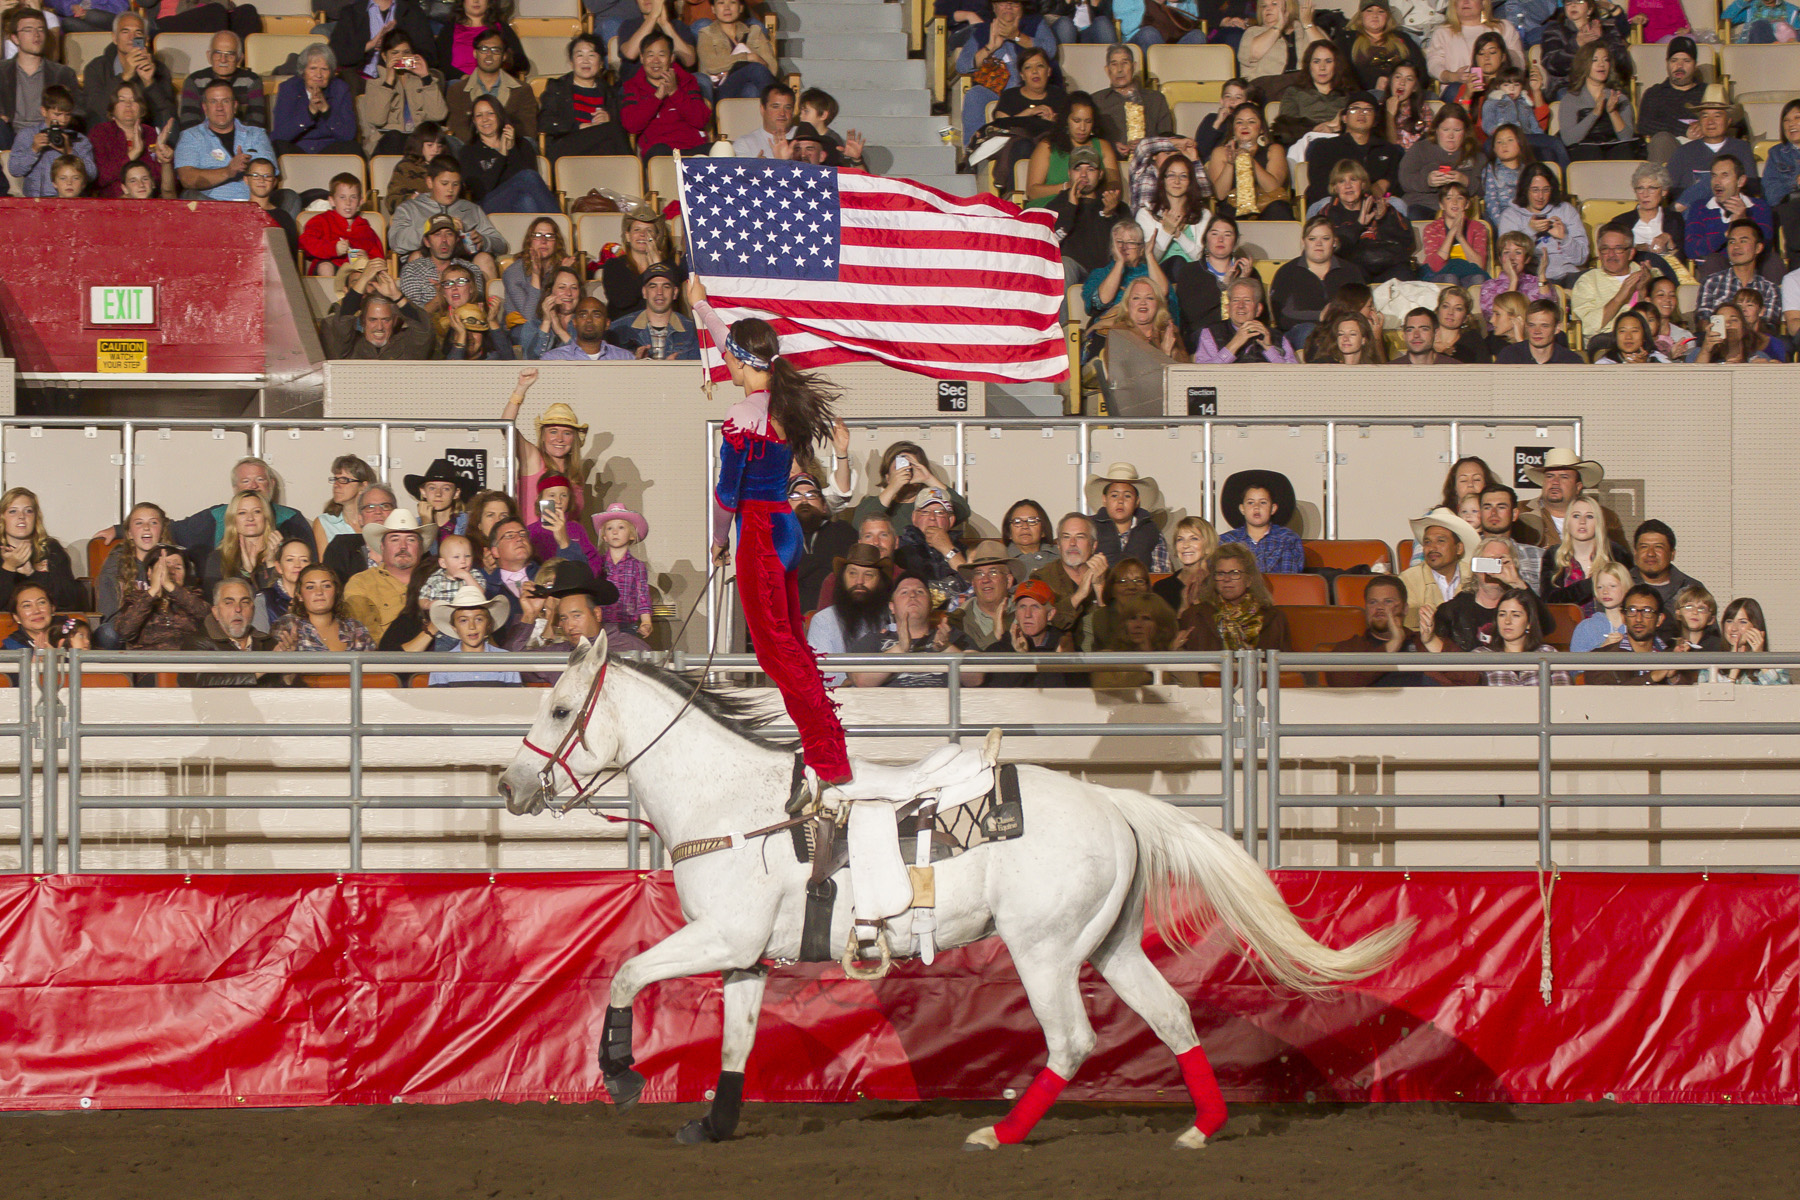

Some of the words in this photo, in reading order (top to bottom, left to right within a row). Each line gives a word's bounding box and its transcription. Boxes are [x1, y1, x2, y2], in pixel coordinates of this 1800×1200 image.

[937, 25, 943, 34] H
[104, 289, 143, 319] EXIT
[1070, 332, 1077, 342] C
[101, 342, 143, 351] CAUTION
[103, 361, 121, 369] YOUR
[124, 361, 140, 369] STEP
[939, 382, 967, 396] Sec
[950, 397, 966, 409] 16
[1199, 403, 1216, 416] 14
[447, 454, 475, 467] Box
[1516, 452, 1543, 465] Box
